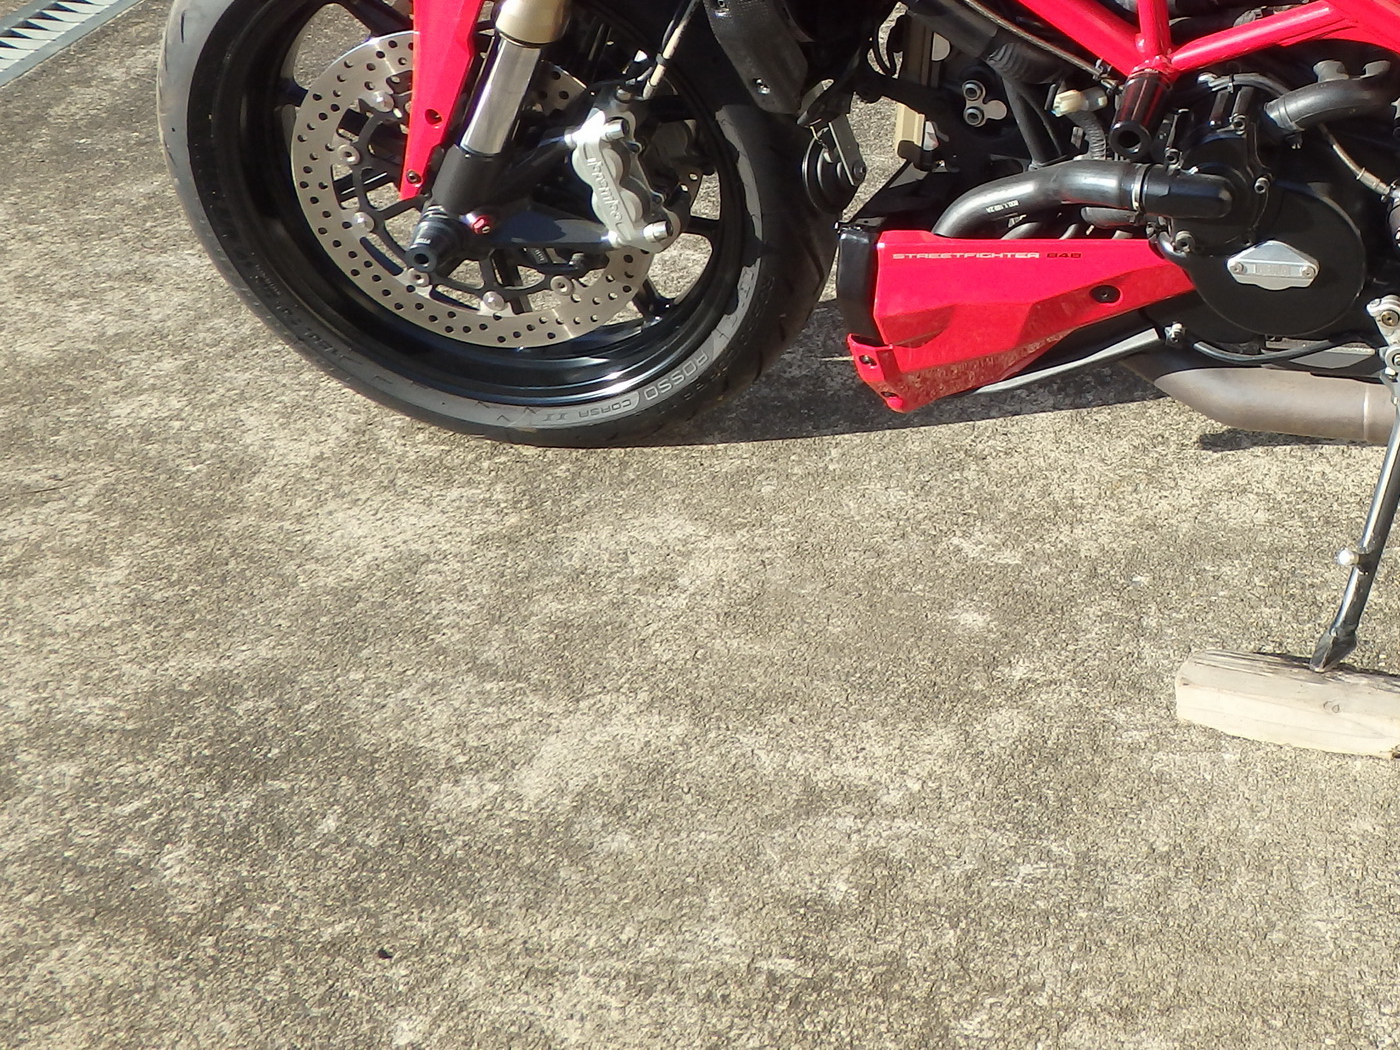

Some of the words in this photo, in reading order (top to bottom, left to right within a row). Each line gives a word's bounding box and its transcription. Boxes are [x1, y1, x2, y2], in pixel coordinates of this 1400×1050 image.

[892, 252, 1041, 260] STREETFIGHTER
[643, 351, 710, 401] ROSSO
[578, 399, 633, 419] CORSA
